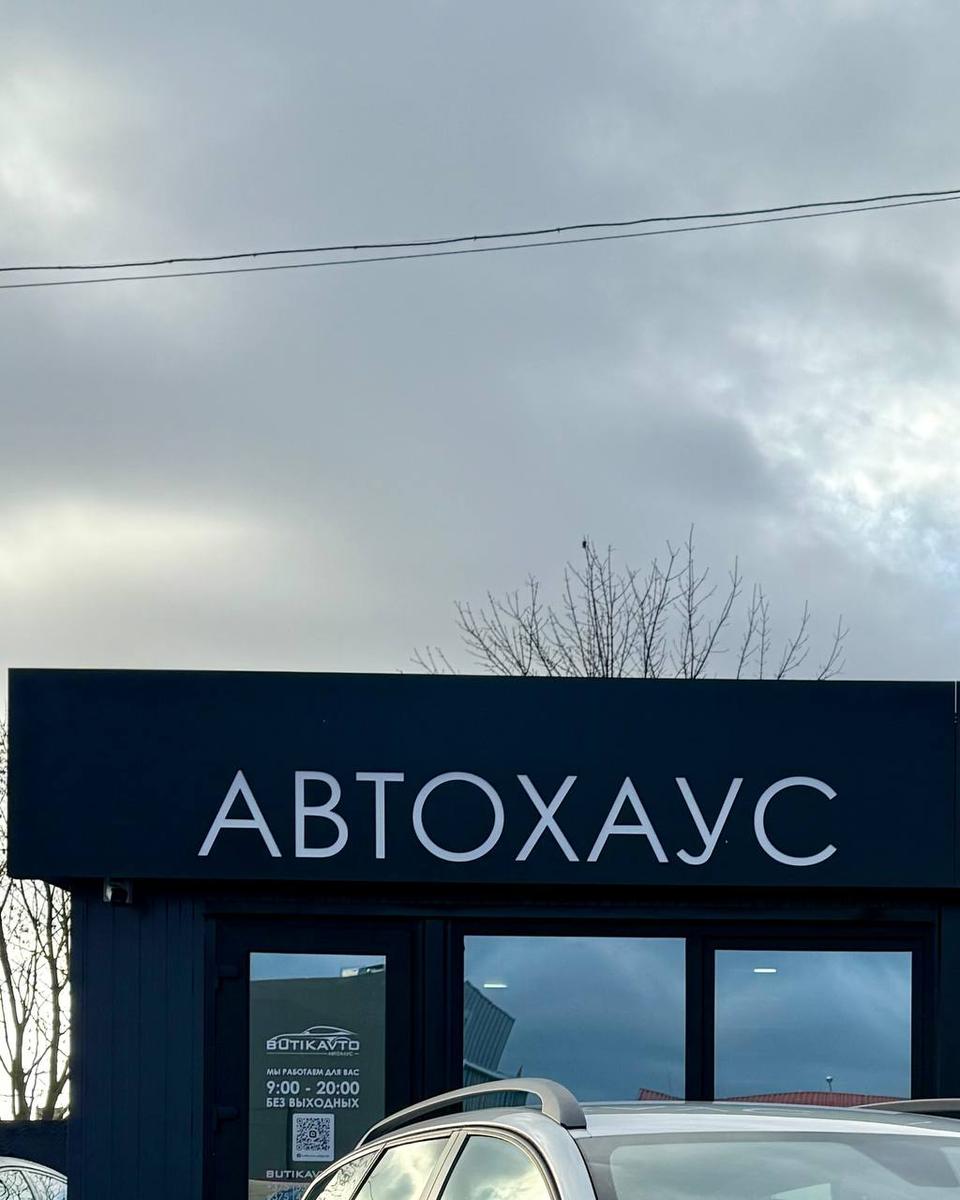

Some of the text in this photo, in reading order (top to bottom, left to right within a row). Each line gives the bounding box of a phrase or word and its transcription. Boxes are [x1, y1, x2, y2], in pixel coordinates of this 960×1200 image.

[197, 769, 838, 867] АВТОХАУС
[266, 1039, 360, 1051] BUTIKAVTO
[266, 1068, 281, 1076] МЫ
[282, 1068, 324, 1076] РАБОТАЕМ
[266, 1080, 300, 1095] 9:00
[316, 1080, 360, 1095] 20:00
[266, 1097, 360, 1109] БЕЗ ВЫХОДНЫХ
